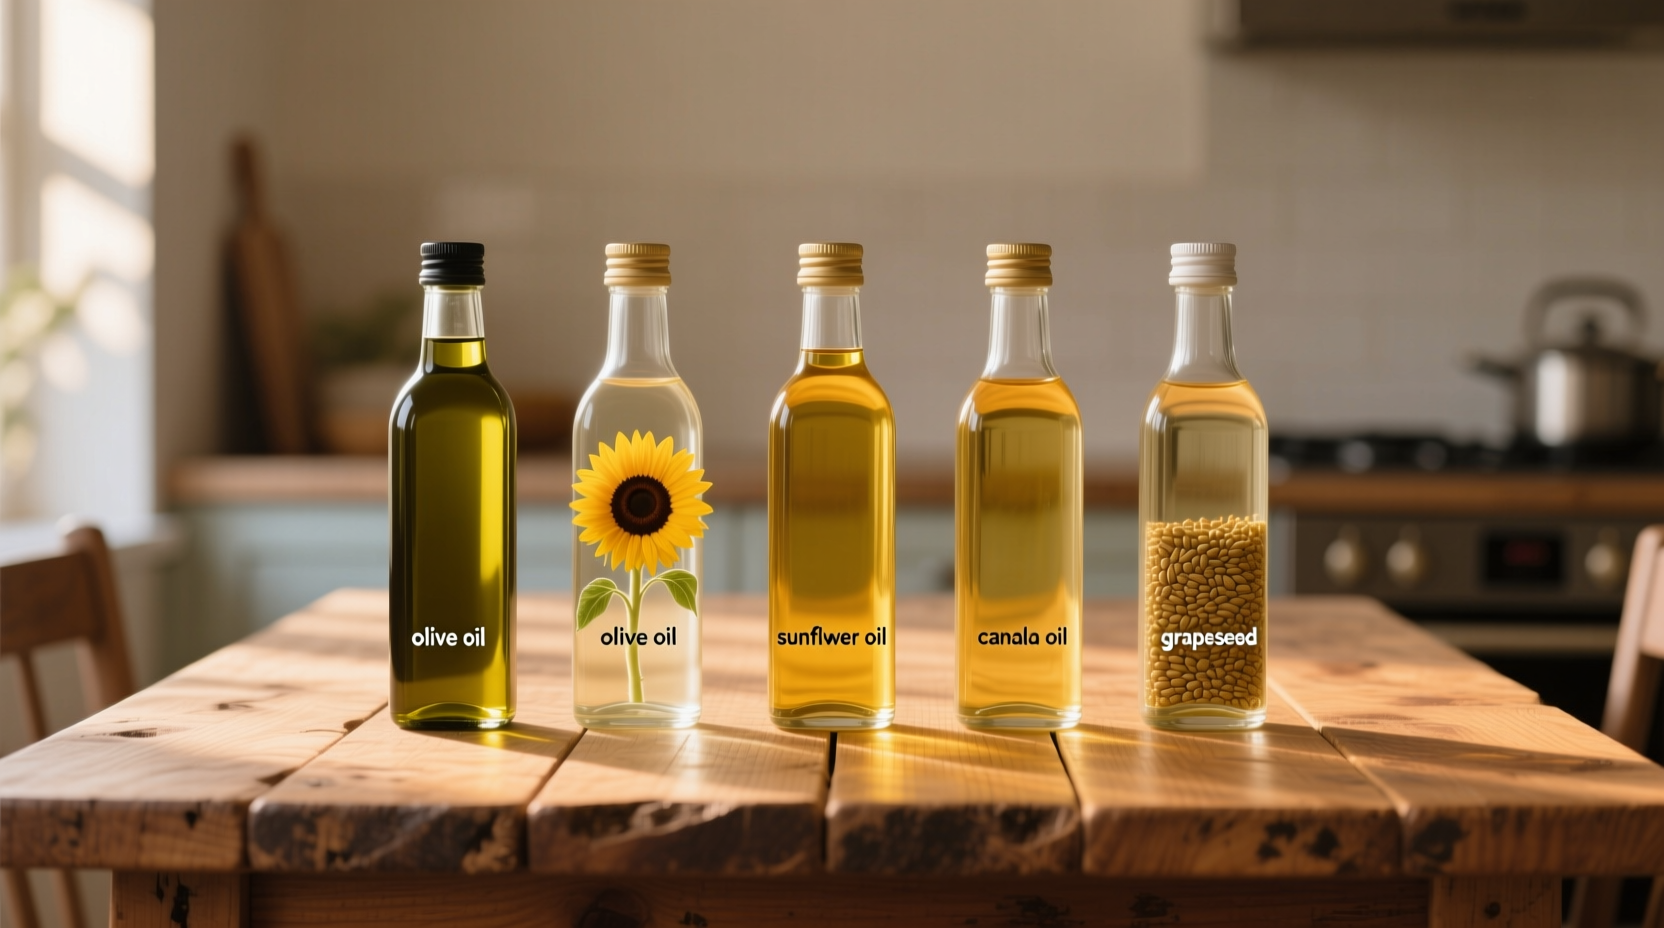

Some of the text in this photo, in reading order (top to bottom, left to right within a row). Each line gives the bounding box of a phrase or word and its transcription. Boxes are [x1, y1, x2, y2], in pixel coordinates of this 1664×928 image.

[412, 626, 485, 647] olive oil
[600, 626, 676, 645] olive oil
[777, 625, 886, 645] sunflwer oil
[1045, 626, 1067, 645] oil
